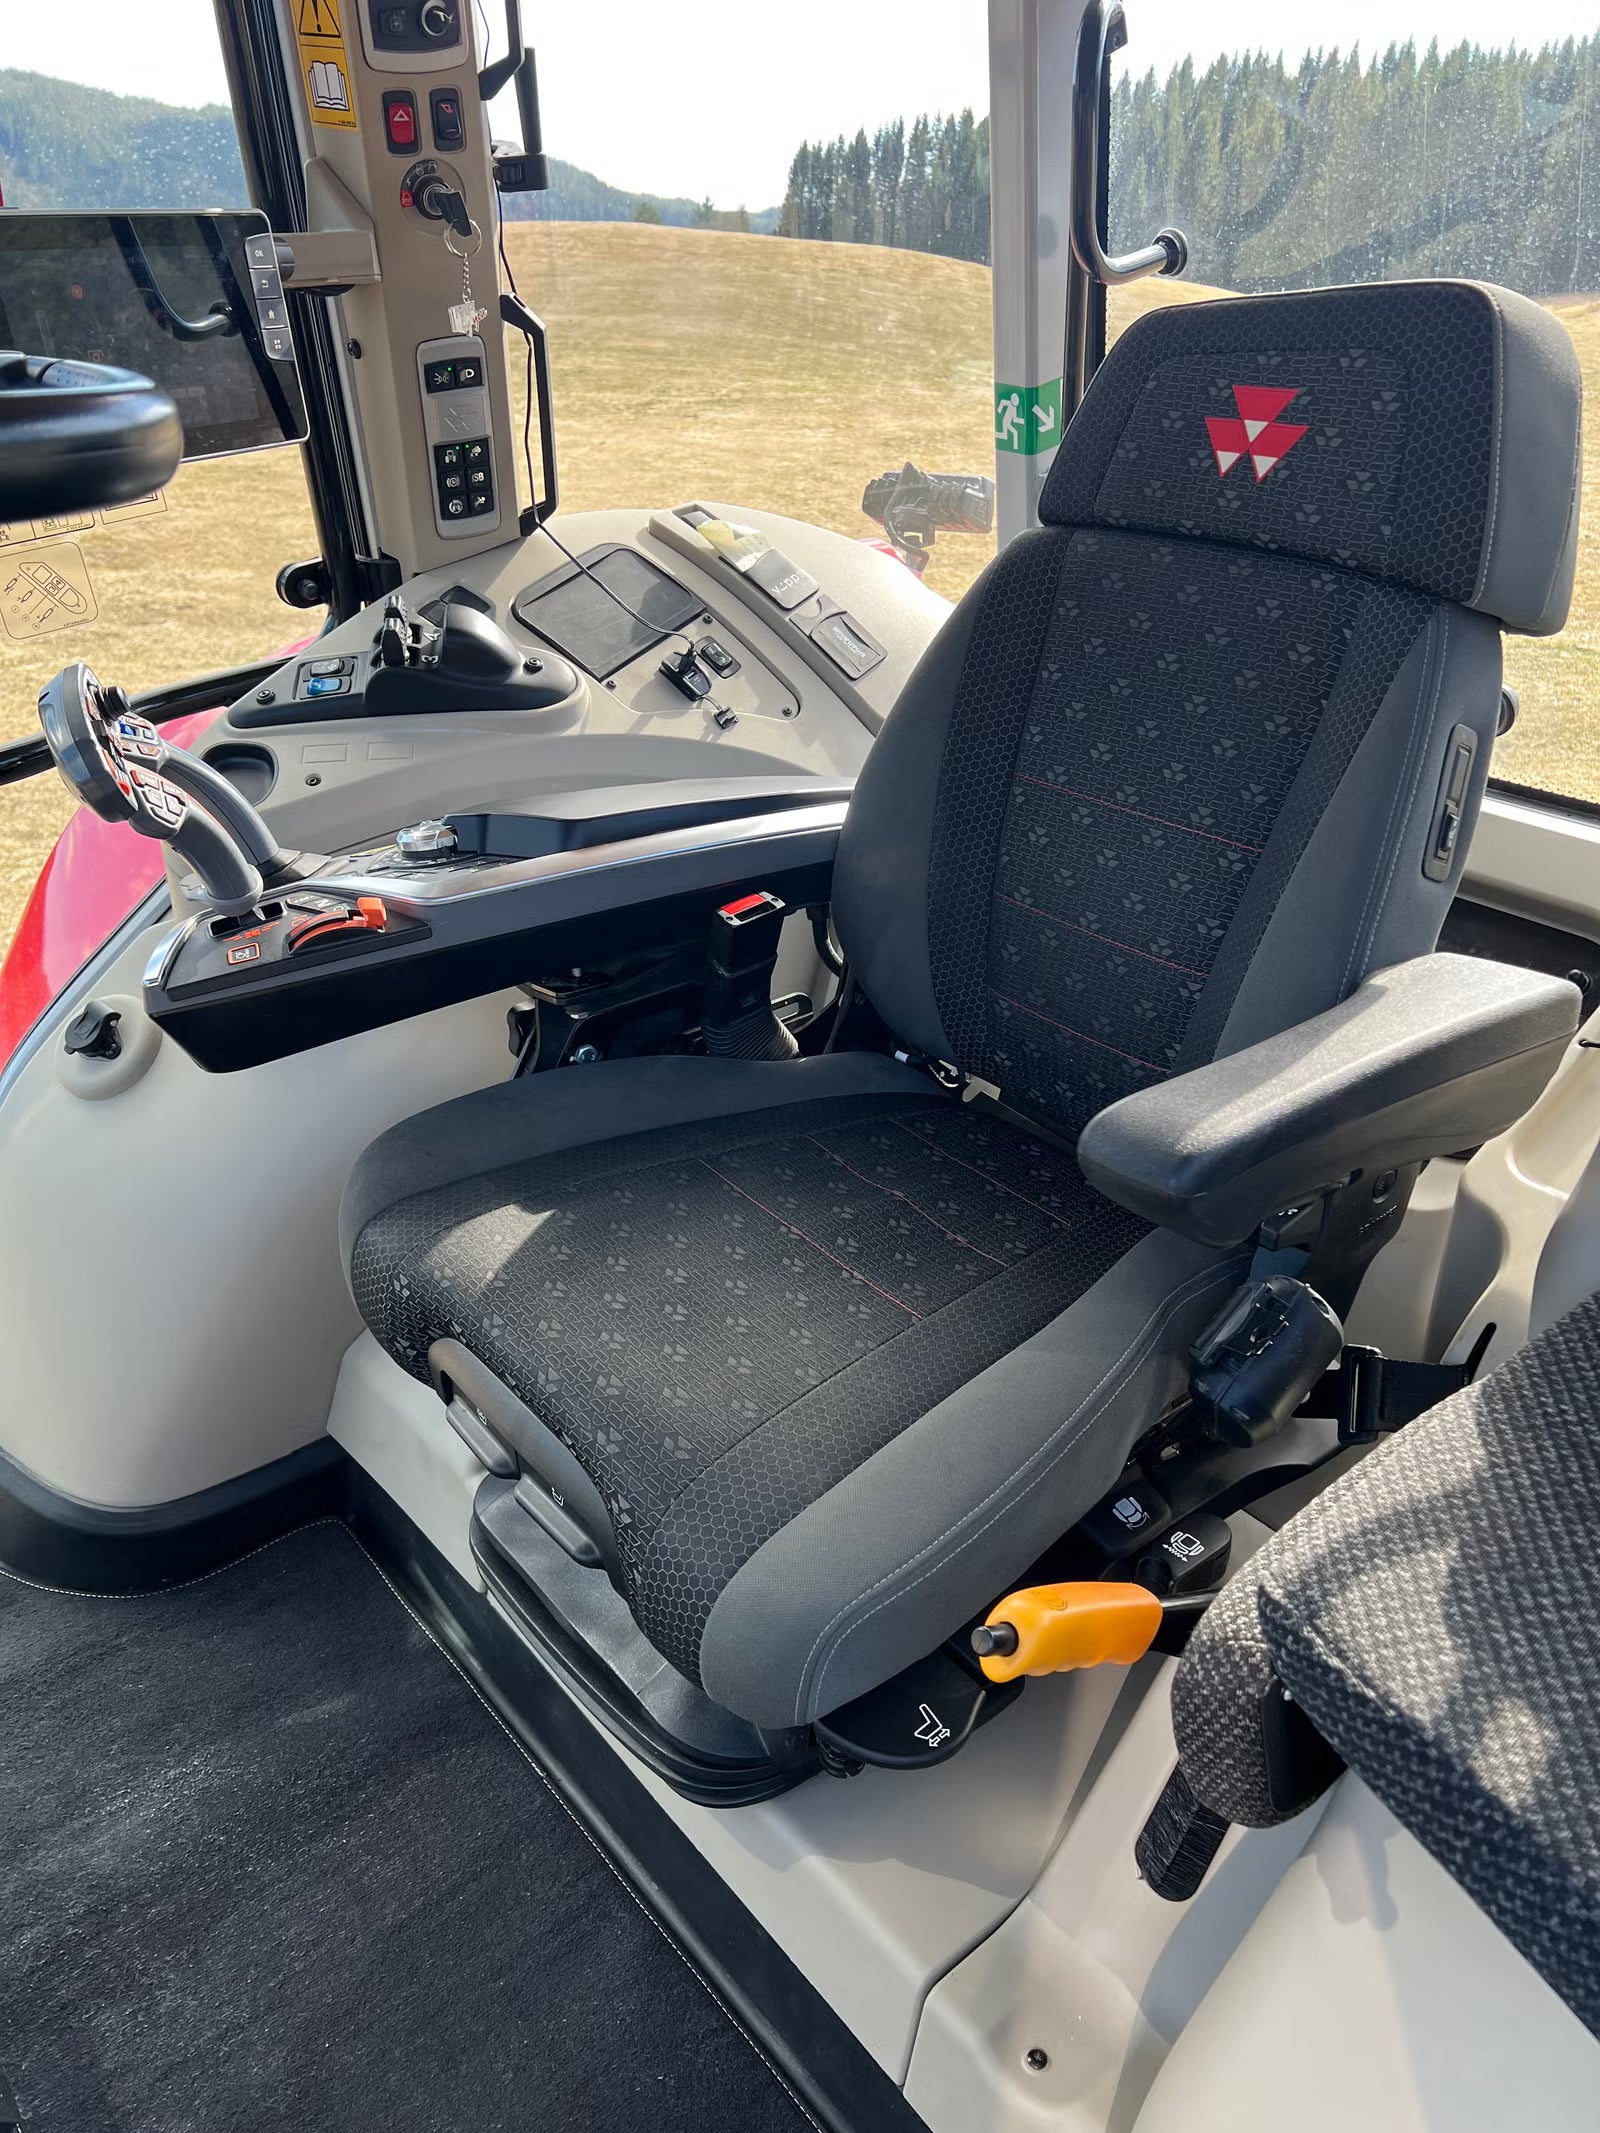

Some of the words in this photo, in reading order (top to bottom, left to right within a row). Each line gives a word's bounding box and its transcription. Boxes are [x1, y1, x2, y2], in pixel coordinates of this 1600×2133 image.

[254, 249, 264, 258] OK
[422, 632, 441, 642] 4
[421, 655, 439, 664] 3
